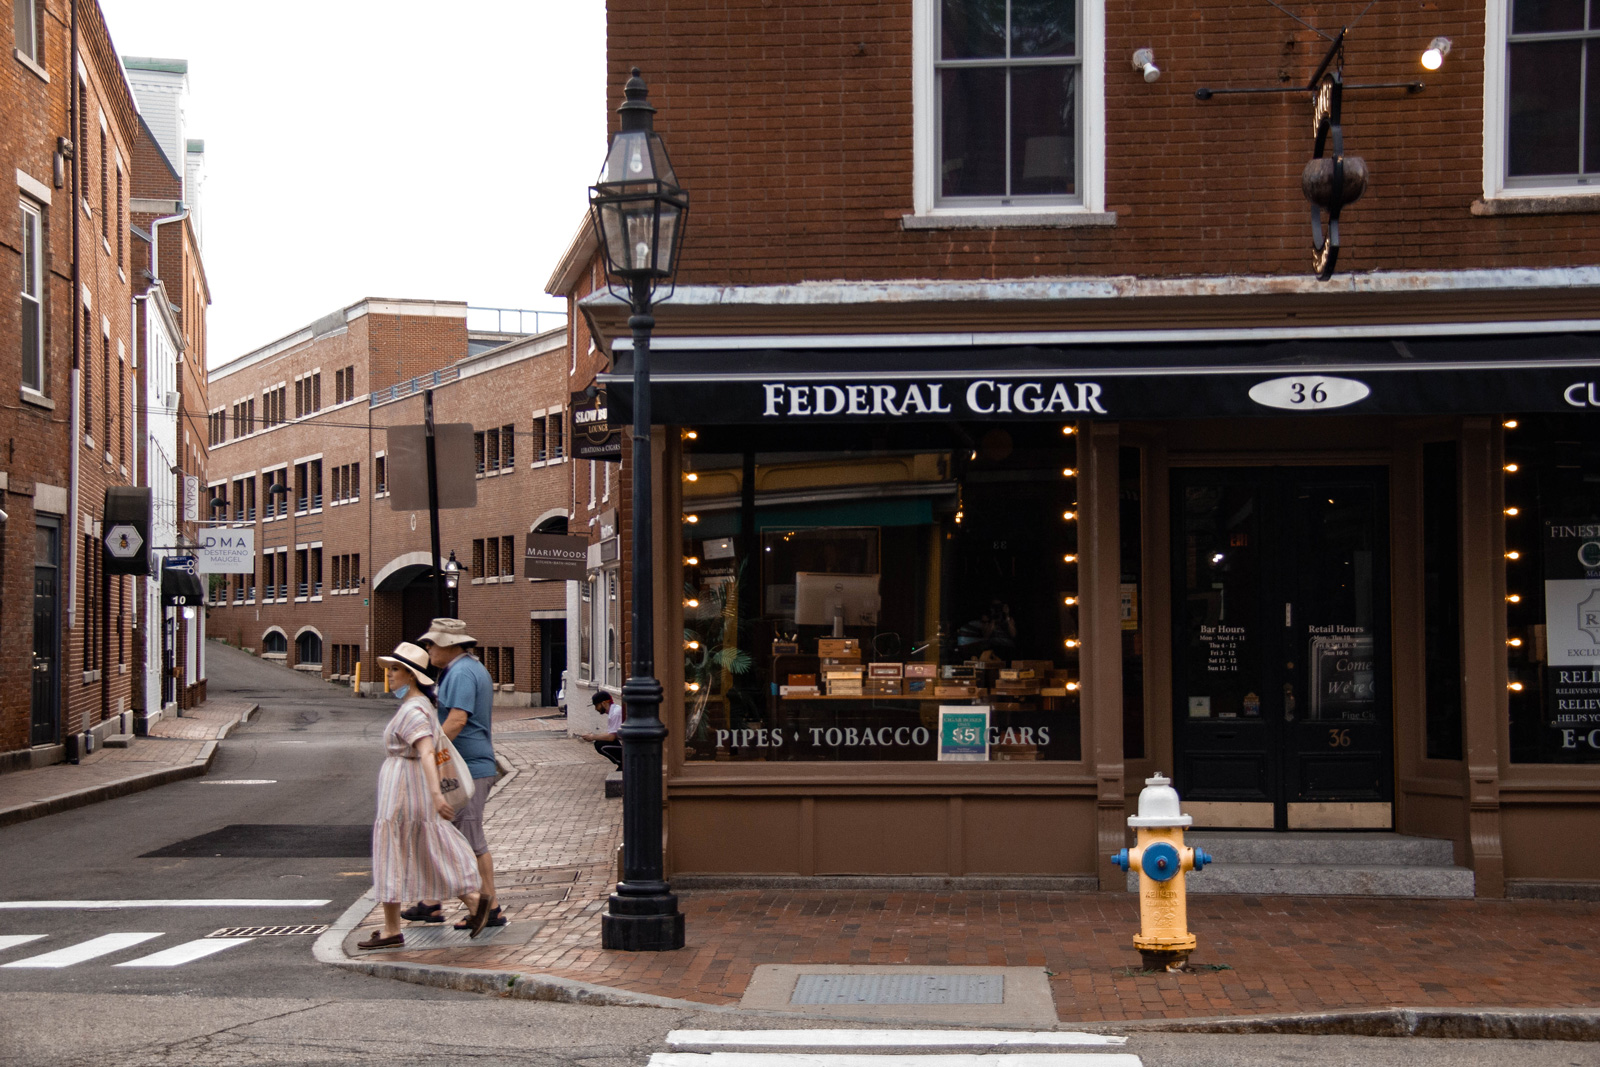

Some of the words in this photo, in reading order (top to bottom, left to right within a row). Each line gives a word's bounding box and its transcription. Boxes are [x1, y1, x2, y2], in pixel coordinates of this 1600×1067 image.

[763, 383, 951, 416] FEDERAL
[966, 381, 1107, 414] CIGAR
[1290, 382, 1328, 404] 36
[575, 410, 597, 424] SLOW
[185, 478, 196, 519] CALYPSO
[206, 537, 247, 548] DMA
[172, 596, 187, 605] 10
[1200, 625, 1216, 634] Bar
[1218, 625, 1245, 634] Hours
[1308, 625, 1334, 633] Retail
[1336, 625, 1364, 633] Hours
[1567, 649, 1600, 657] EXCLU
[1336, 659, 1373, 671] Come
[1559, 670, 1600, 684] RELI
[1328, 681, 1365, 694] We're
[1557, 714, 1587, 723] HELPS
[716, 728, 783, 748] PIPES
[809, 727, 930, 747] TOBACCO
[957, 726, 1050, 746] CIGARS
[952, 728, 975, 741] $5
[1328, 729, 1352, 747] 36
